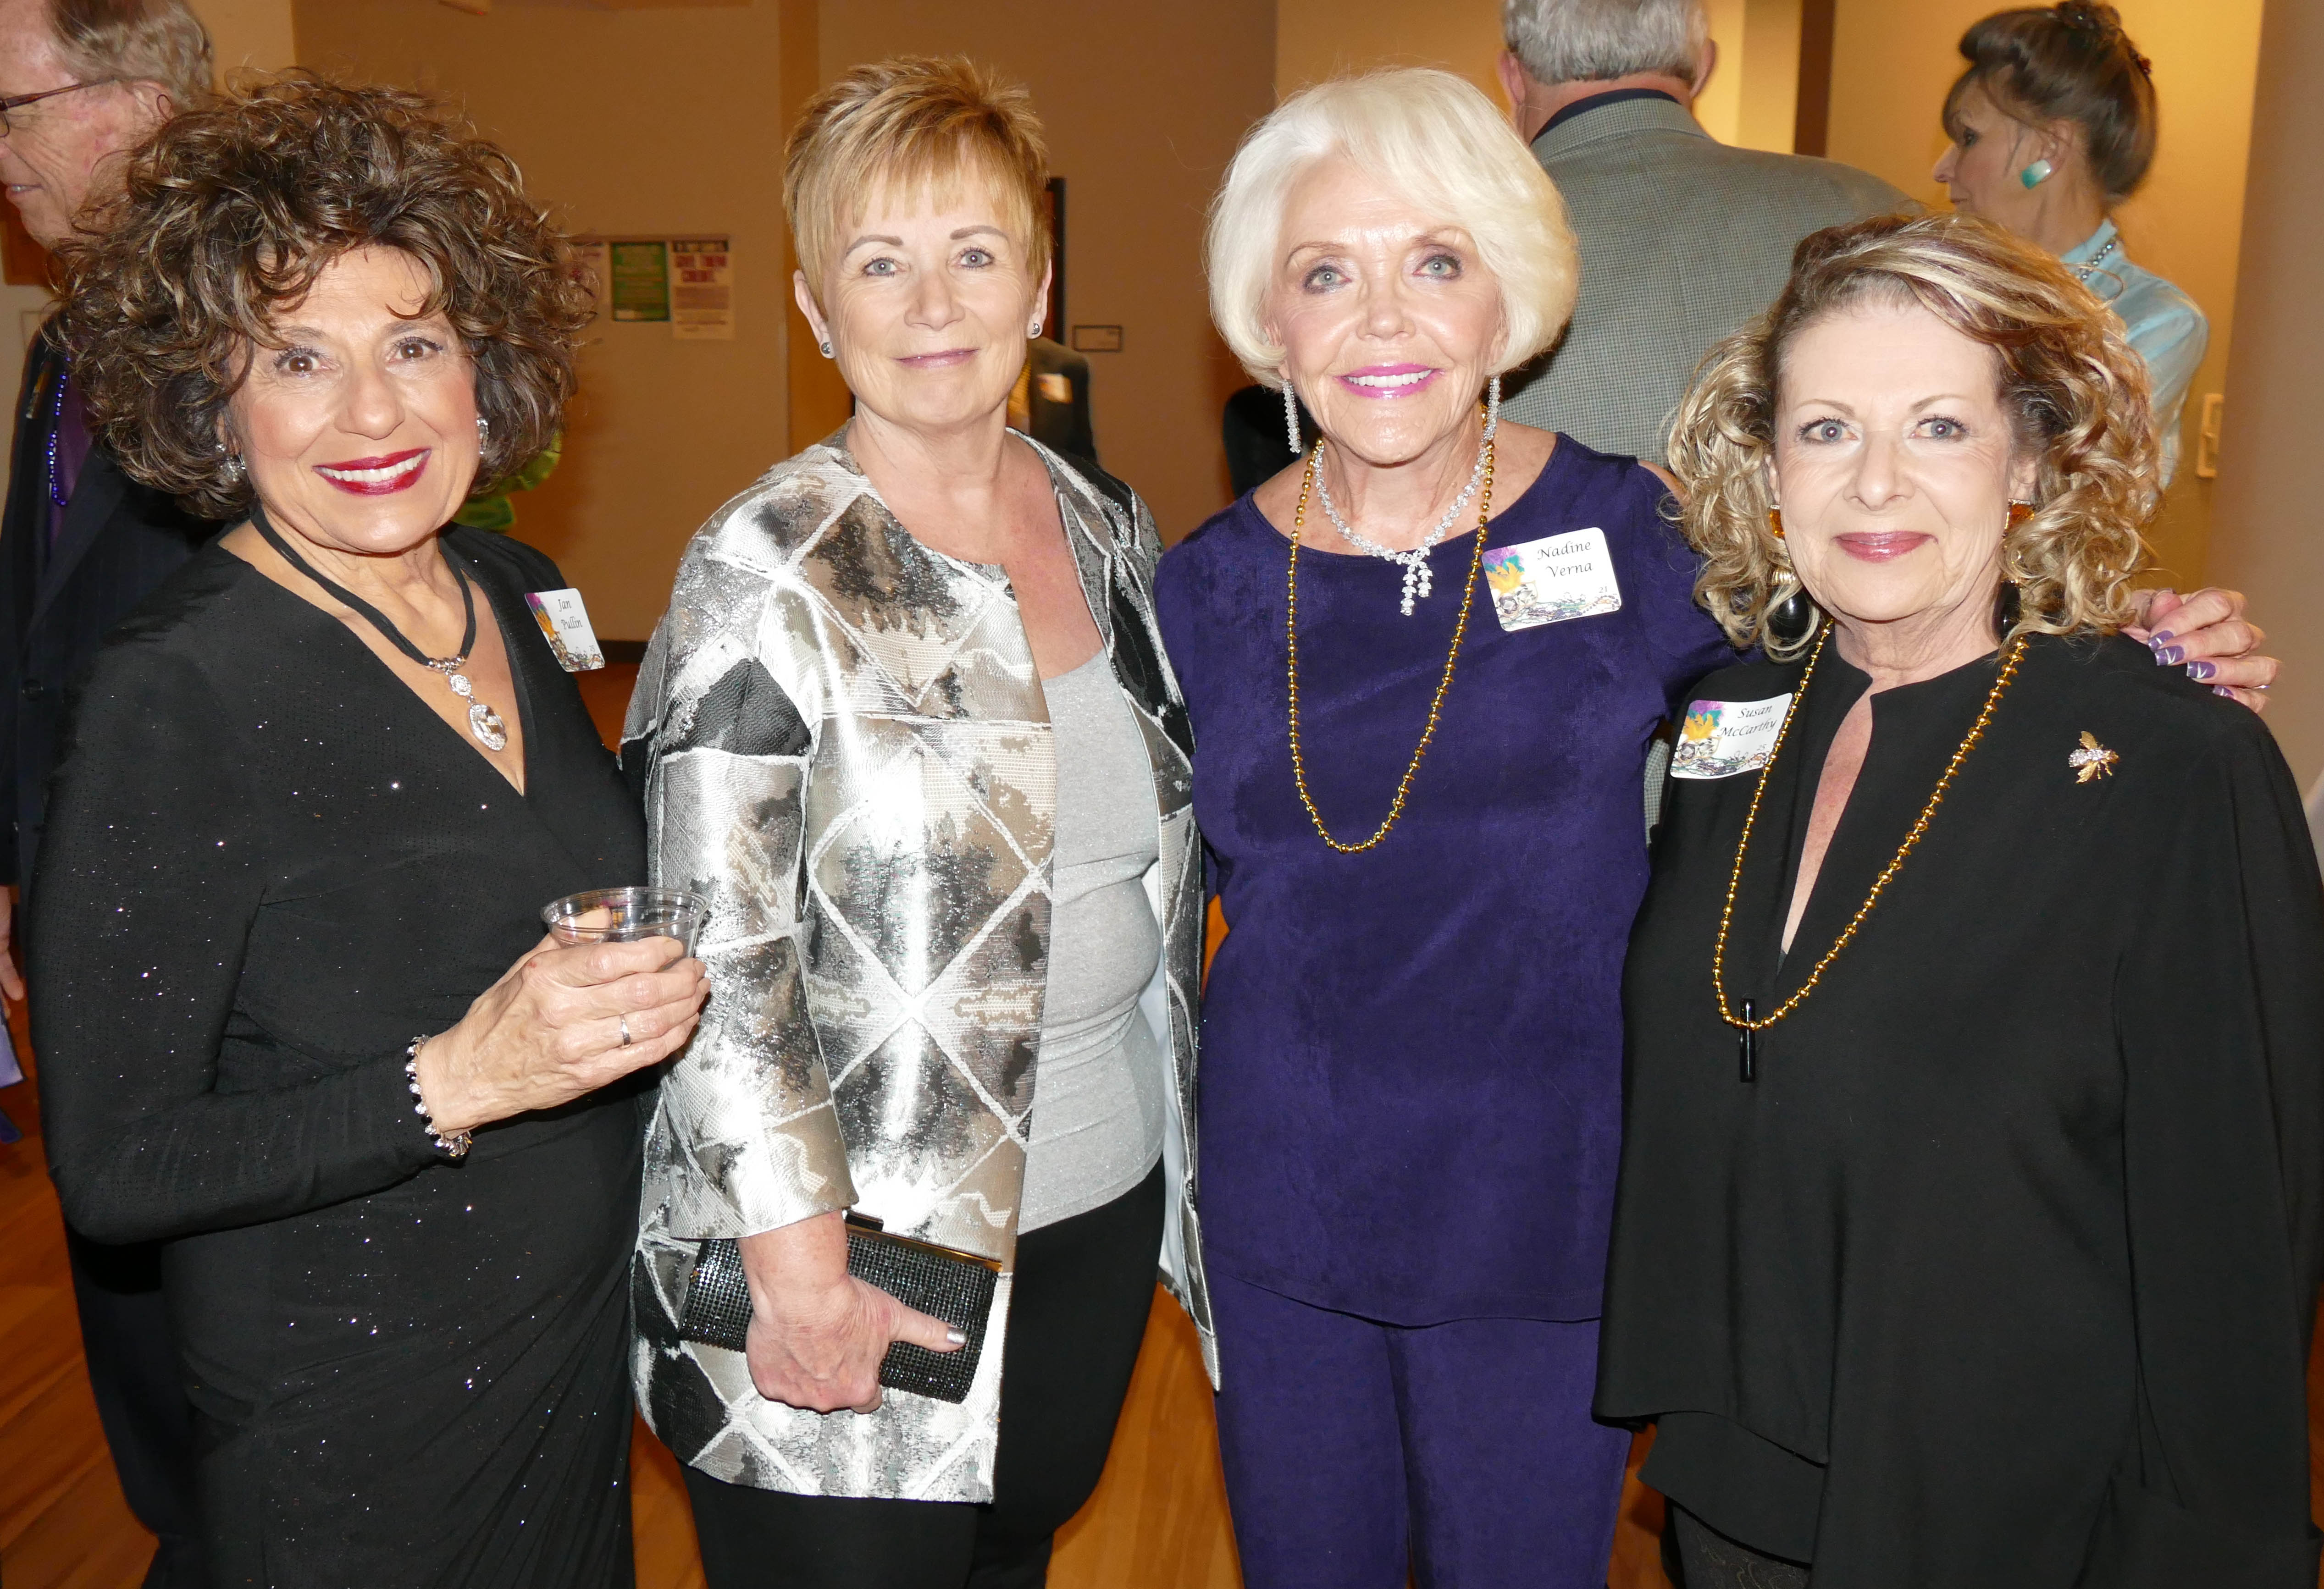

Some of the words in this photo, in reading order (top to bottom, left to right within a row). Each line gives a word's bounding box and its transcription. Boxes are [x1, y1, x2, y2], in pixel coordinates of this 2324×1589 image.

[1538, 541, 1591, 560] Nadine
[1546, 563, 1594, 577] Verna
[558, 599, 571, 612] Jan
[1737, 705, 1772, 718] Susan
[1717, 718, 1777, 737] McCarthy
